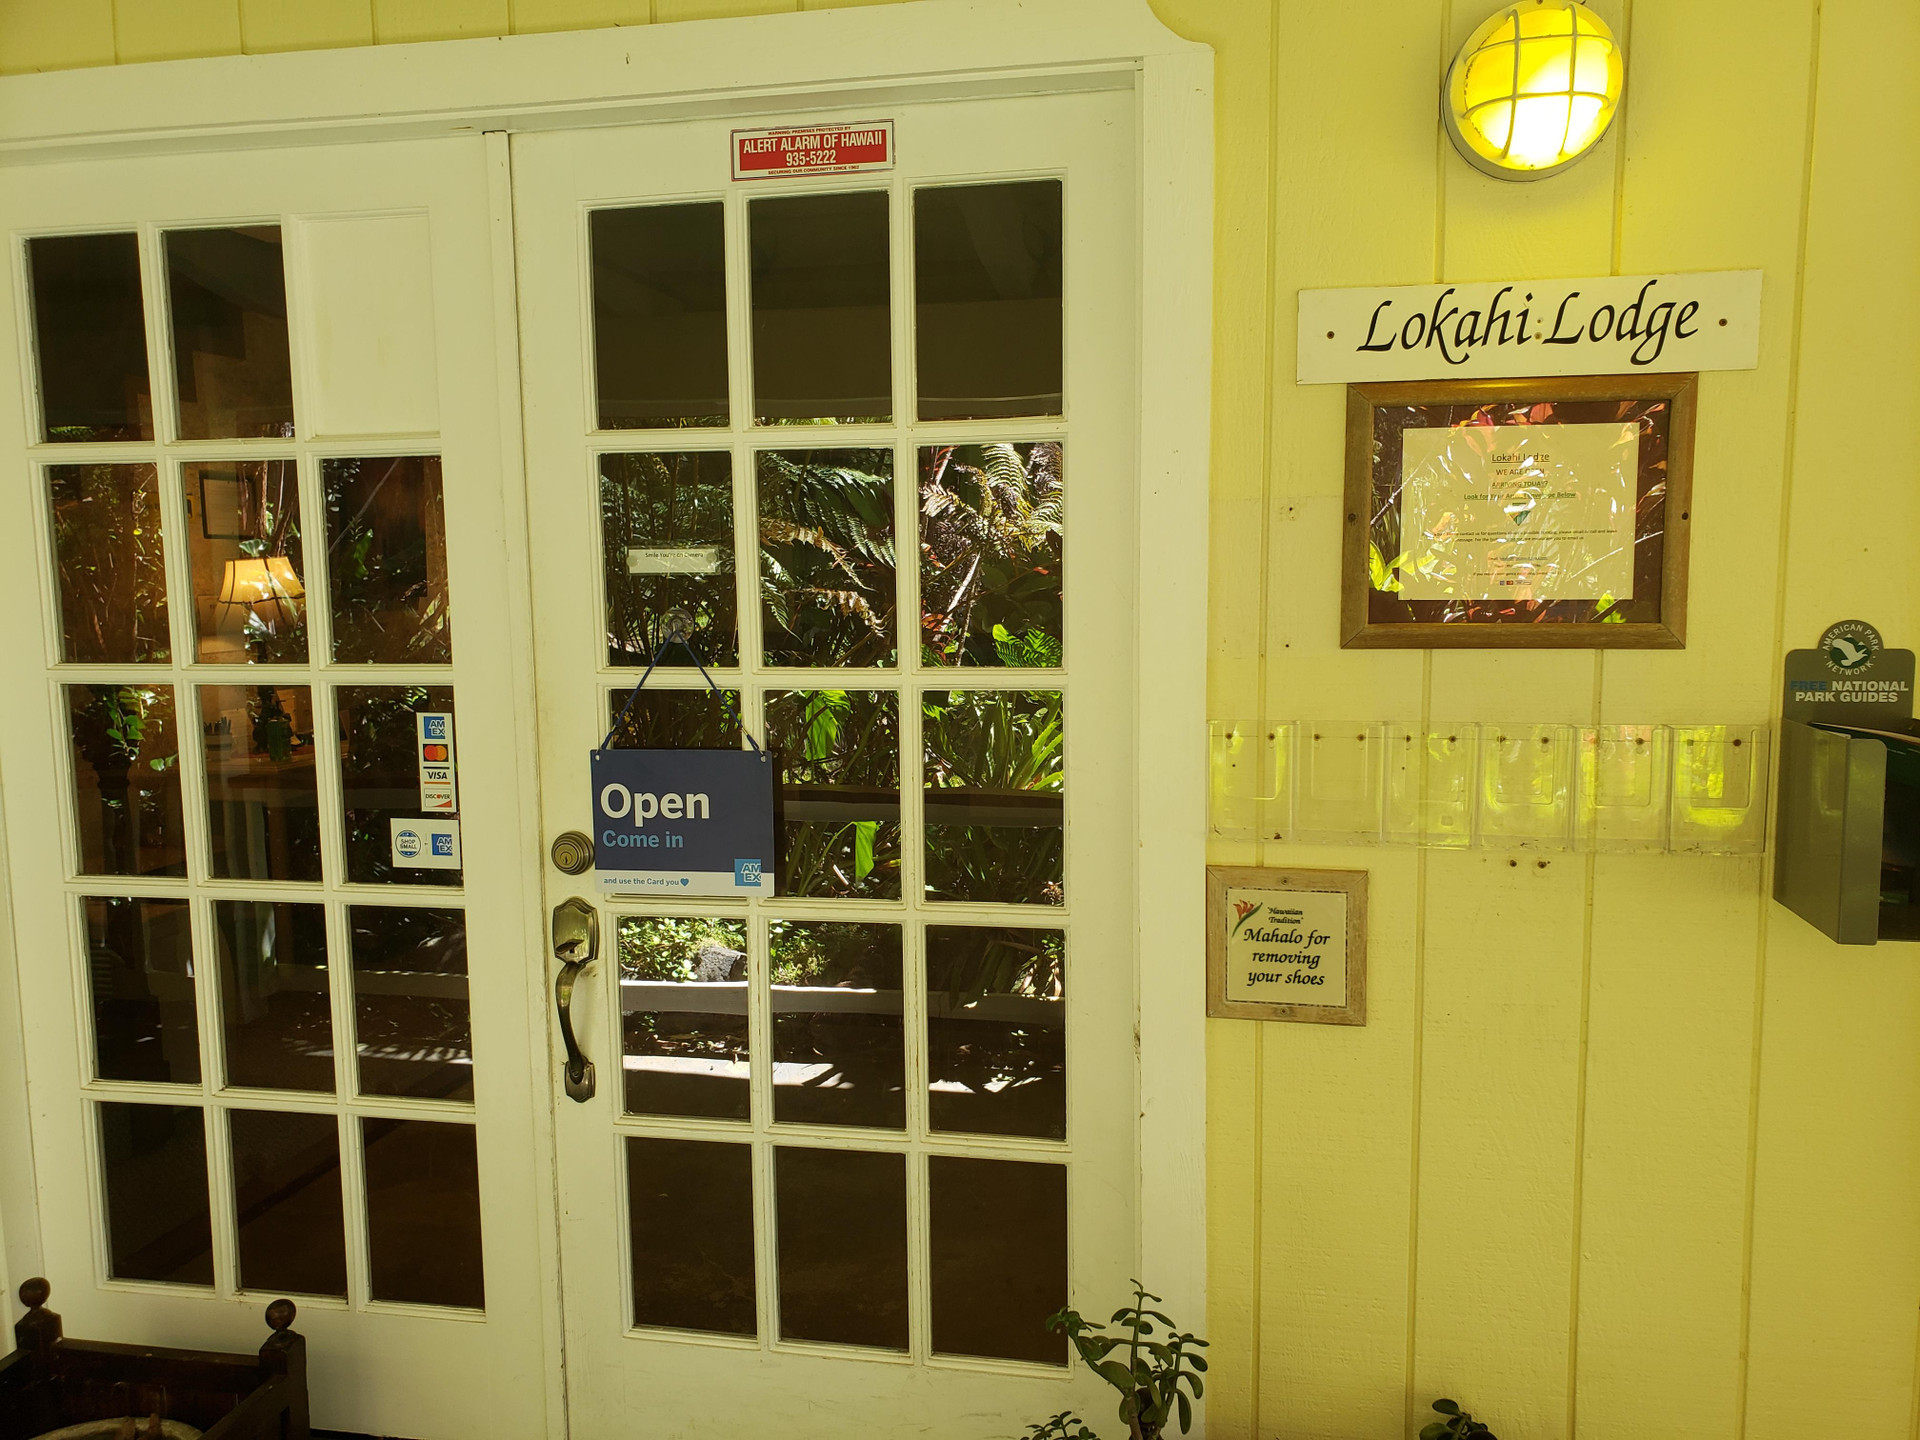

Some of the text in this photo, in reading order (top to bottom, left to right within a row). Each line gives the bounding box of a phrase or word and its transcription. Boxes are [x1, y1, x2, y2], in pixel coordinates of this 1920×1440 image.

[744, 131, 882, 153] ALERT ALARM OF HAWAII
[786, 150, 836, 166] 935-5222
[1355, 280, 1699, 366] Lokahi Lodge
[1492, 453, 1520, 462] Lokahi
[1822, 624, 1879, 651] AMERICAN PARK
[1826, 661, 1874, 675] NETWORK
[1790, 681, 1909, 691] FREE NATIONAL
[1795, 692, 1898, 702] PARK GUIDES
[427, 771, 447, 779] VISA
[601, 783, 710, 827] Open
[602, 830, 683, 848] Come in
[1243, 928, 1330, 949] Mahalo for
[1252, 951, 1320, 969] removing
[1247, 969, 1325, 986] your shoes
